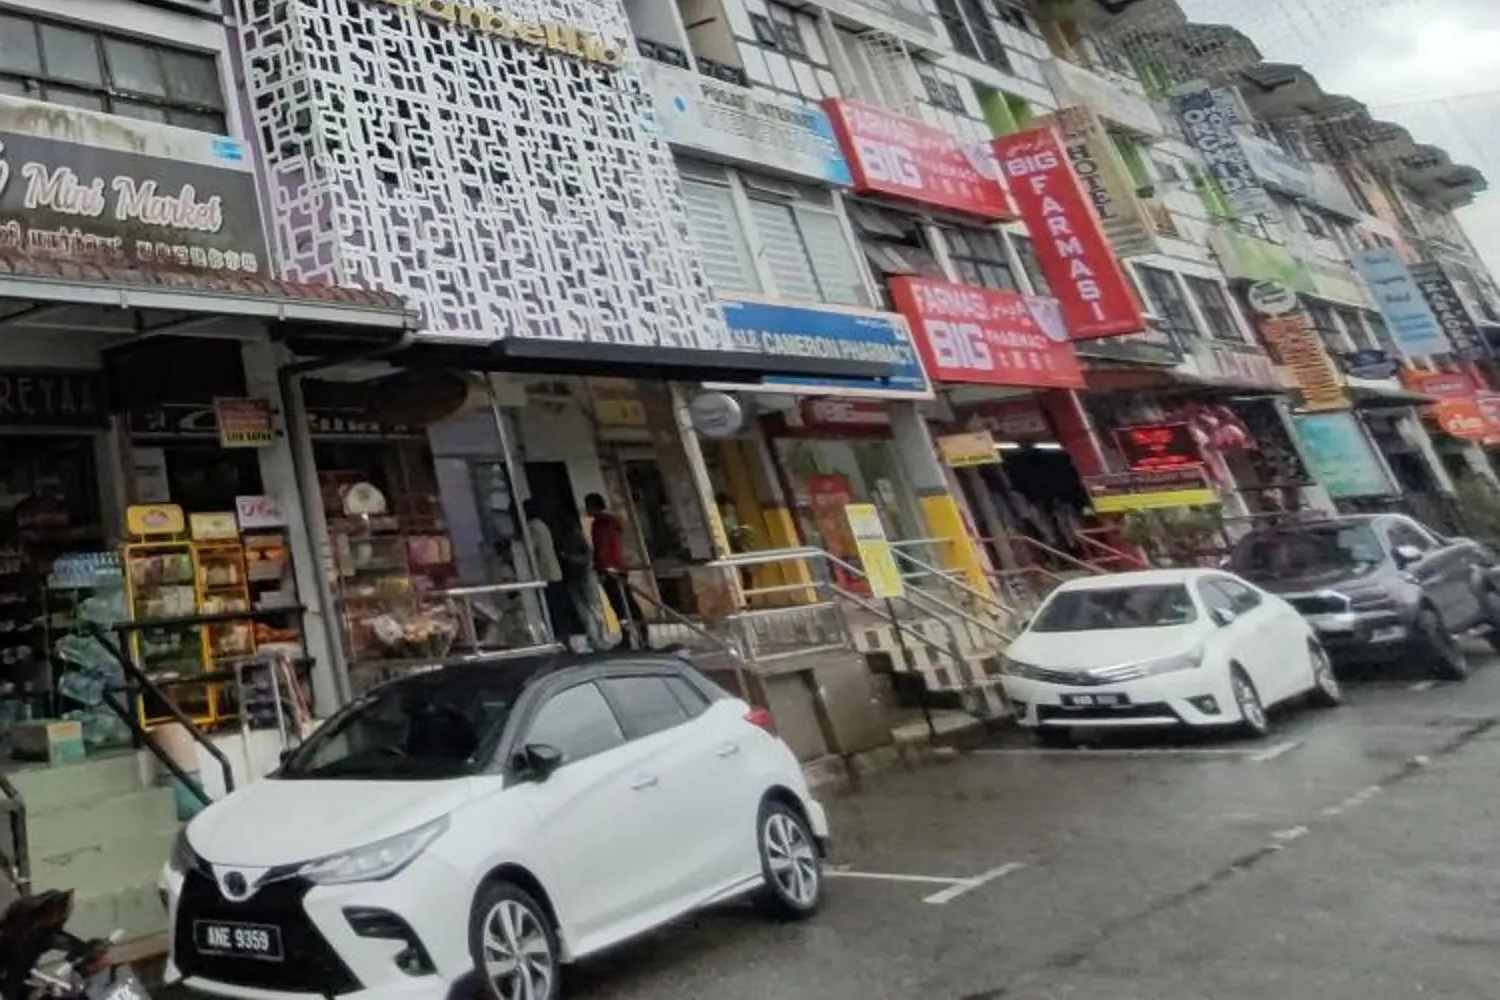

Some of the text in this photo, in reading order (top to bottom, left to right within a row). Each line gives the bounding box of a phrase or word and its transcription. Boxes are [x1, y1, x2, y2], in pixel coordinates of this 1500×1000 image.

[852, 135, 923, 189] BIG
[1006, 150, 1058, 177] BIG
[22, 160, 106, 219] Mini
[111, 175, 224, 235] Market
[1028, 173, 1107, 322] FARMASI
[923, 318, 995, 371] BIG
